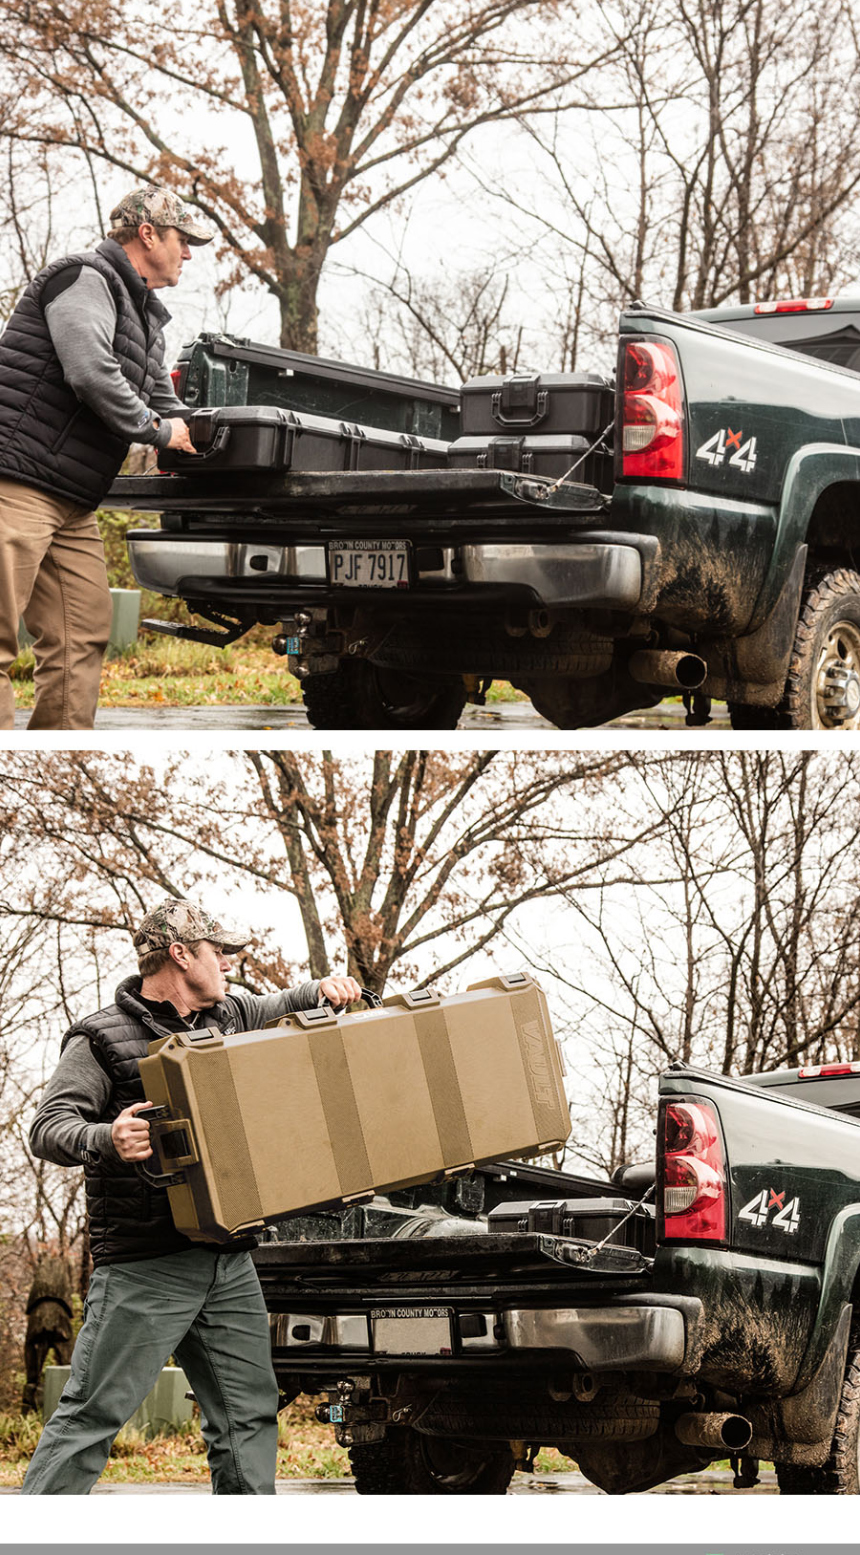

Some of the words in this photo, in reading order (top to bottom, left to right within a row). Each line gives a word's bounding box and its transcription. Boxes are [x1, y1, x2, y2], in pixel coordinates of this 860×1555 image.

[355, 540, 380, 549] COUNTY
[334, 554, 363, 580] PJF
[368, 554, 405, 580] 7917
[521, 1019, 555, 1110] VAULT
[396, 1309, 422, 1317] COUNTY
[423, 1308, 449, 1317] MOORS
